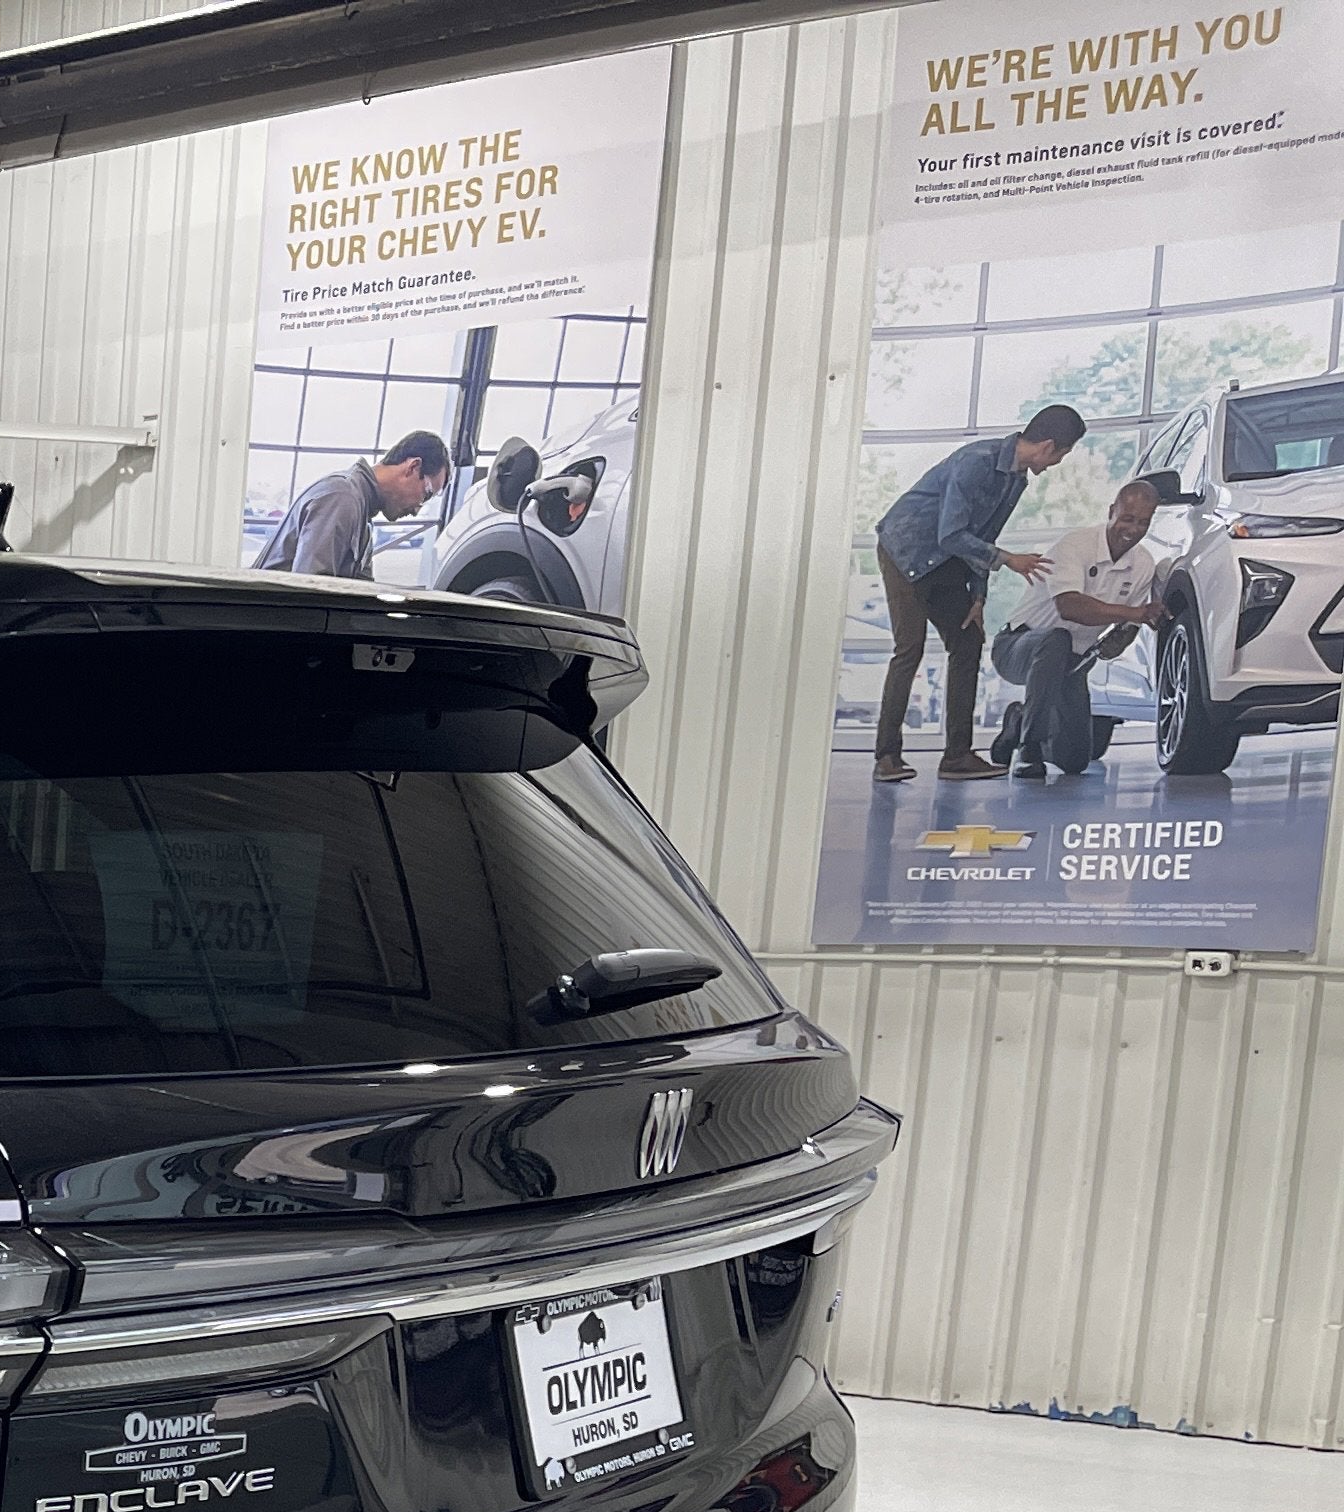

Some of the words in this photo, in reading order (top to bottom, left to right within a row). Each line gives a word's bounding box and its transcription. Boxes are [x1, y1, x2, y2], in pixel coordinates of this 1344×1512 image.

[926, 43, 1055, 93] WE'RE
[1068, 25, 1179, 75] WITH
[1195, 7, 1283, 54] YOU
[920, 97, 995, 137] ALL
[1011, 84, 1090, 126] THE
[1104, 67, 1203, 115] WAY.
[292, 160, 341, 195] WE
[349, 142, 448, 187] KNOW
[458, 129, 522, 168] THE
[915, 182, 957, 193] Includes:
[958, 180, 969, 189] oil
[970, 177, 988, 188] and
[990, 176, 1001, 186] oil
[1002, 173, 1026, 184] filter
[1027, 171, 1065, 183] change,
[1066, 166, 1095, 178] diesel
[1096, 160, 1134, 174] exhaust
[1137, 157, 1159, 170] fluid
[1161, 154, 1183, 166] tank
[1185, 151, 1210, 163] refill
[1212, 147, 1231, 160] (for
[1233, 134, 1316, 156] diesel-equipped
[917, 157, 957, 173] Your
[961, 151, 1001, 169] first
[1006, 137, 1125, 165] maintenance
[1130, 131, 1172, 150] visit
[1176, 127, 1192, 144] is
[288, 193, 383, 234] RIGHT
[391, 176, 484, 220] TIRES
[494, 164, 559, 204] FOR
[914, 194, 940, 204] 4-tire
[942, 192, 981, 203] rotation,
[983, 188, 1000, 199] and
[1002, 183, 1054, 196] Multi-Point
[1056, 179, 1090, 192] Vehicle
[1092, 173, 1145, 188] Inspection.
[286, 234, 367, 272] YOUR
[376, 216, 488, 262] CHEVY
[496, 208, 548, 244] EV.
[280, 311, 307, 320] Provide
[319, 307, 335, 316] with
[343, 304, 365, 314] better
[367, 300, 393, 312] eligible
[395, 297, 414, 310] price
[416, 297, 424, 305] at
[425, 294, 438, 304] the
[439, 293, 457, 302] time
[458, 290, 467, 299] of
[468, 286, 506, 300] purchase,
[507, 283, 522, 292] and
[543, 276, 569, 287] match
[282, 289, 309, 303] Tire
[312, 284, 348, 301] Price
[351, 277, 394, 296] Match
[398, 268, 476, 290] Guarantee.
[279, 321, 295, 331] Find
[302, 319, 325, 329] better
[326, 317, 345, 328] price
[346, 314, 369, 324] within
[370, 313, 380, 322] 30
[381, 309, 399, 322] days
[400, 309, 409, 318] of
[409, 307, 423, 316] the
[424, 304, 461, 317] purchase,
[462, 300, 477, 310] and
[498, 293, 525, 305] refund
[526, 291, 539, 301] the
[1062, 820, 1224, 850] CERTIFIED
[906, 866, 1037, 882] CHEVROLET
[1058, 853, 1193, 881] SERVICE
[547, 1295, 585, 1316] OLYMPIC
[546, 1352, 647, 1416] OLYMPIC
[124, 1411, 216, 1442] OLYMPIC
[571, 1417, 620, 1448] HURON,
[622, 1411, 639, 1432] SD
[669, 1432, 695, 1452] GMC
[115, 1450, 147, 1465] CHEVY
[159, 1445, 188, 1460] BUICK
[199, 1441, 221, 1455] GMC
[140, 1467, 180, 1483] HURON,
[182, 1464, 195, 1477] SD
[574, 1464, 605, 1483] OLYMPIC
